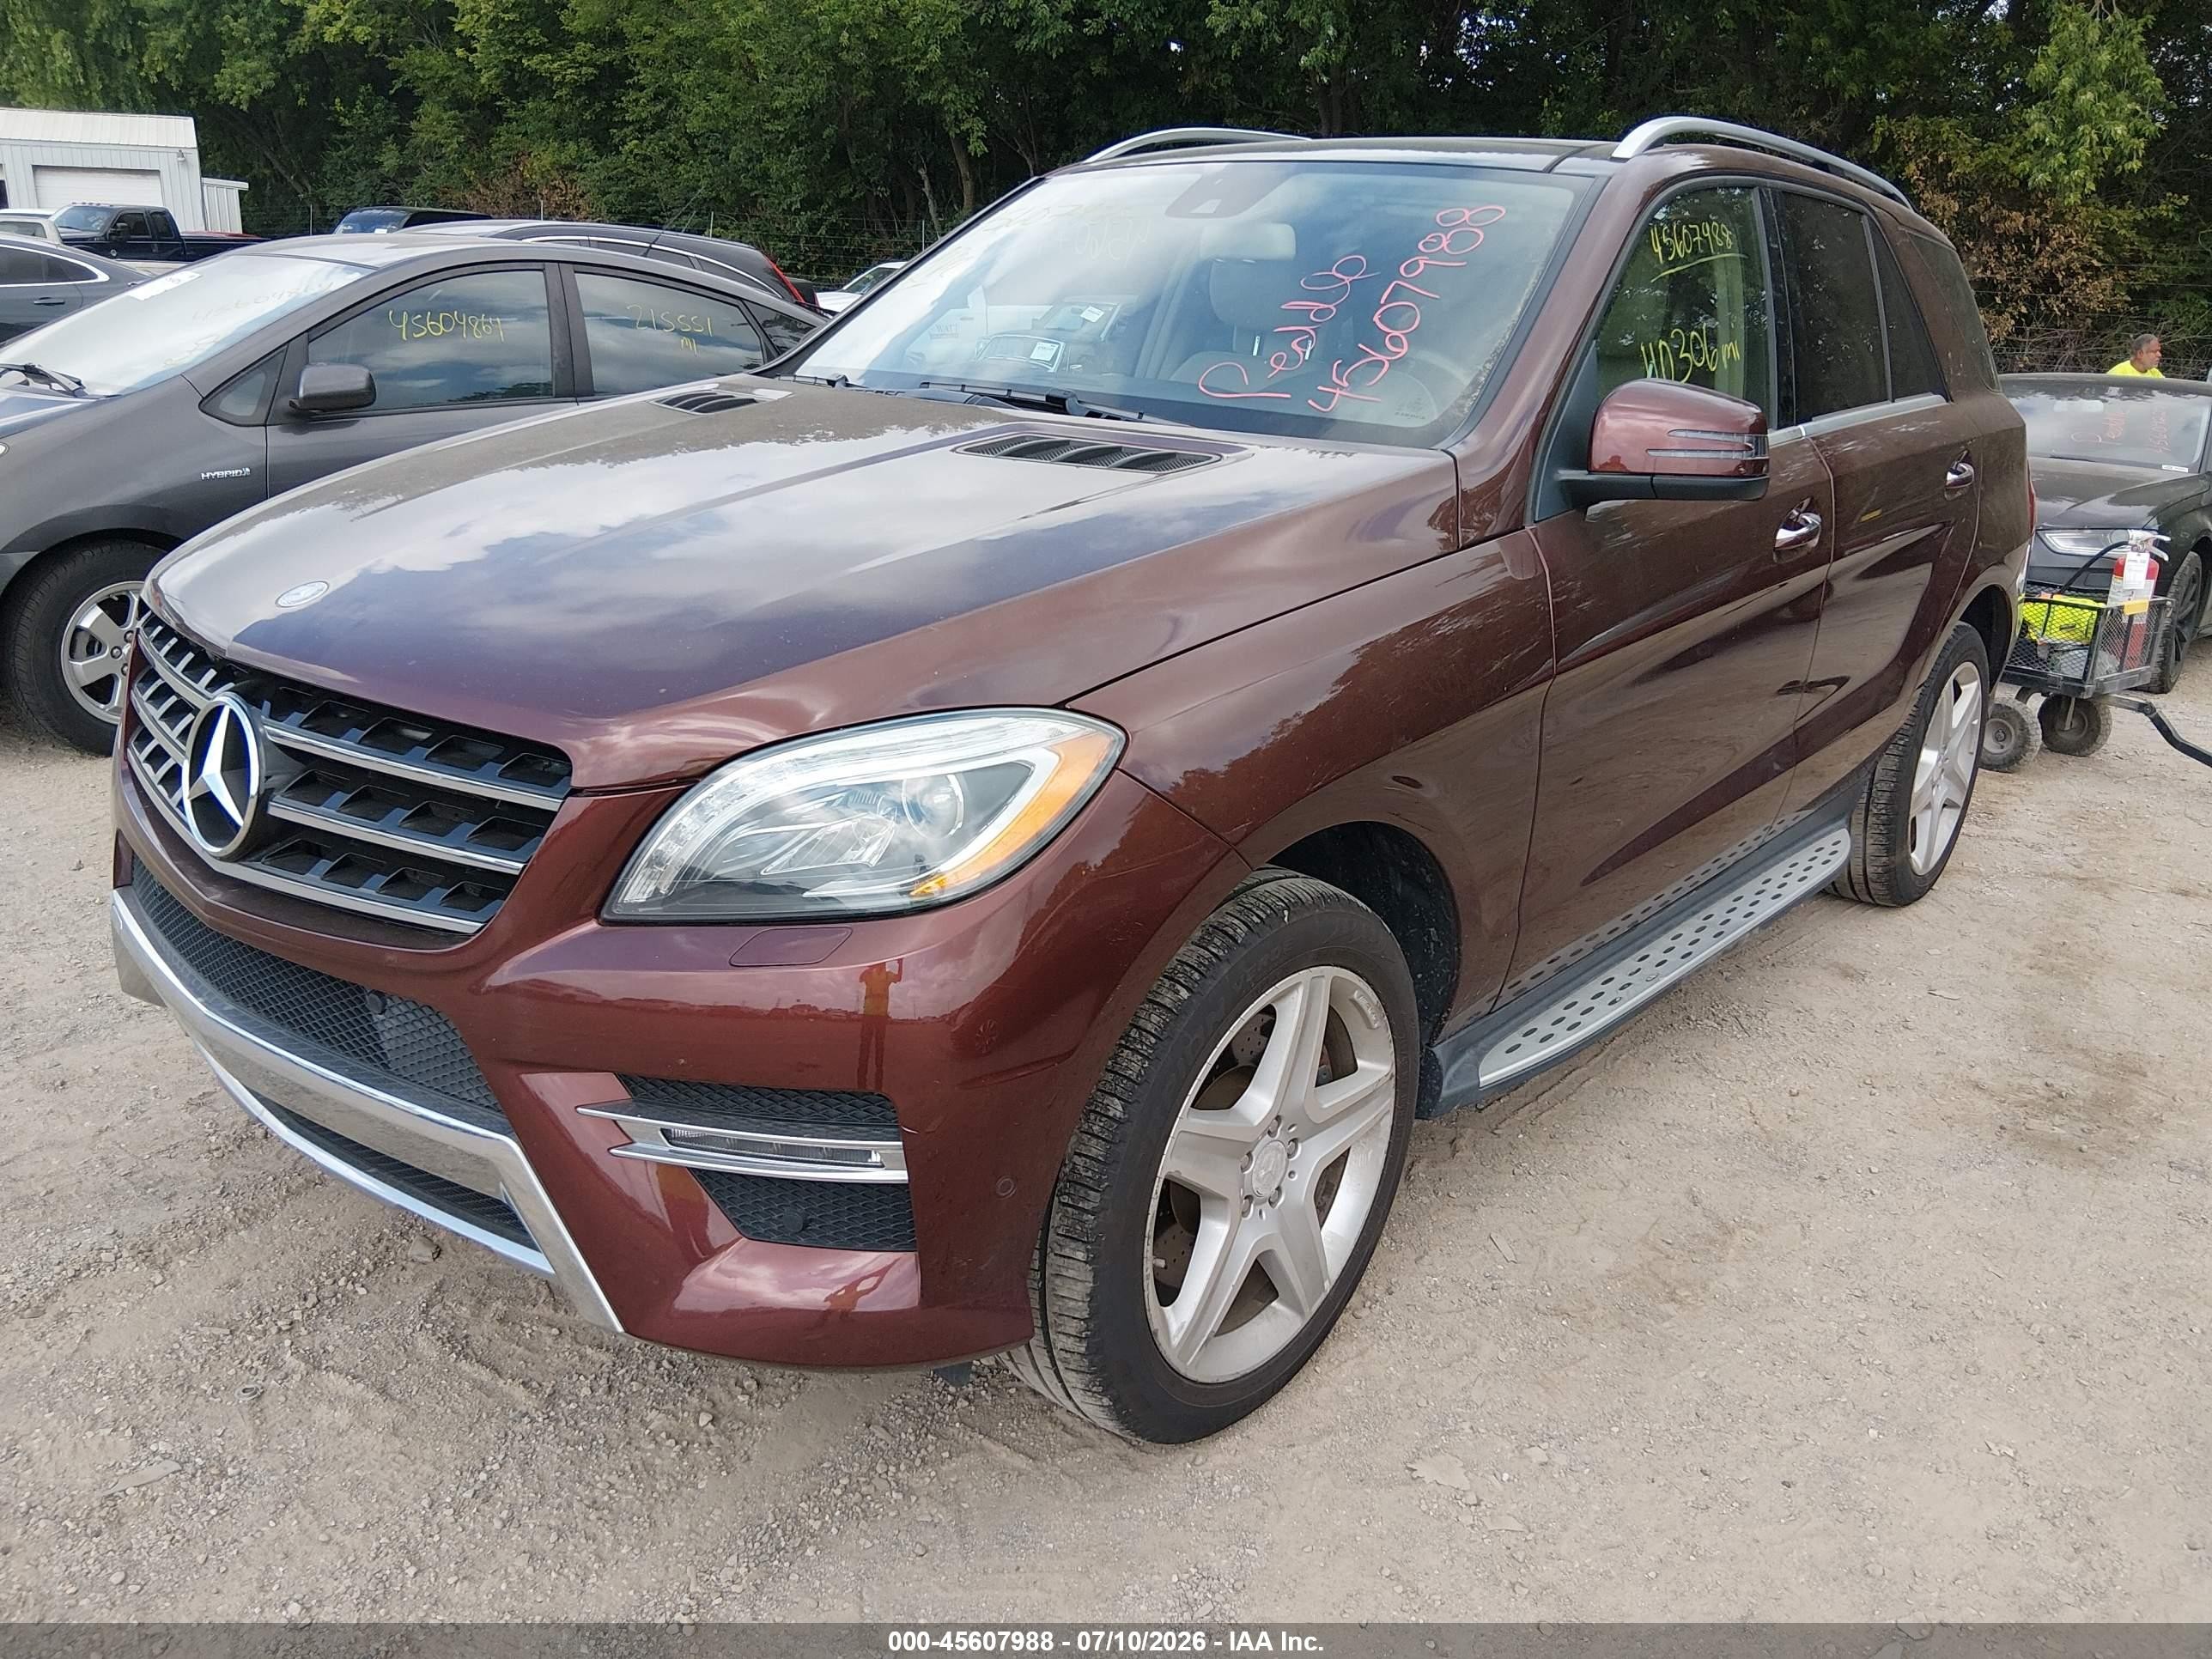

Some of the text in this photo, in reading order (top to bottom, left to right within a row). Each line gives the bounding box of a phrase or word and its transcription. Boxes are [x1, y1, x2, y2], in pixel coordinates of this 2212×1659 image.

[1650, 221, 1733, 264] 45607988
[626, 303, 713, 337] 215551
[1307, 205, 1506, 411] 45607988
[388, 309, 505, 343] 45604864
[200, 469, 242, 480] HYBRID
